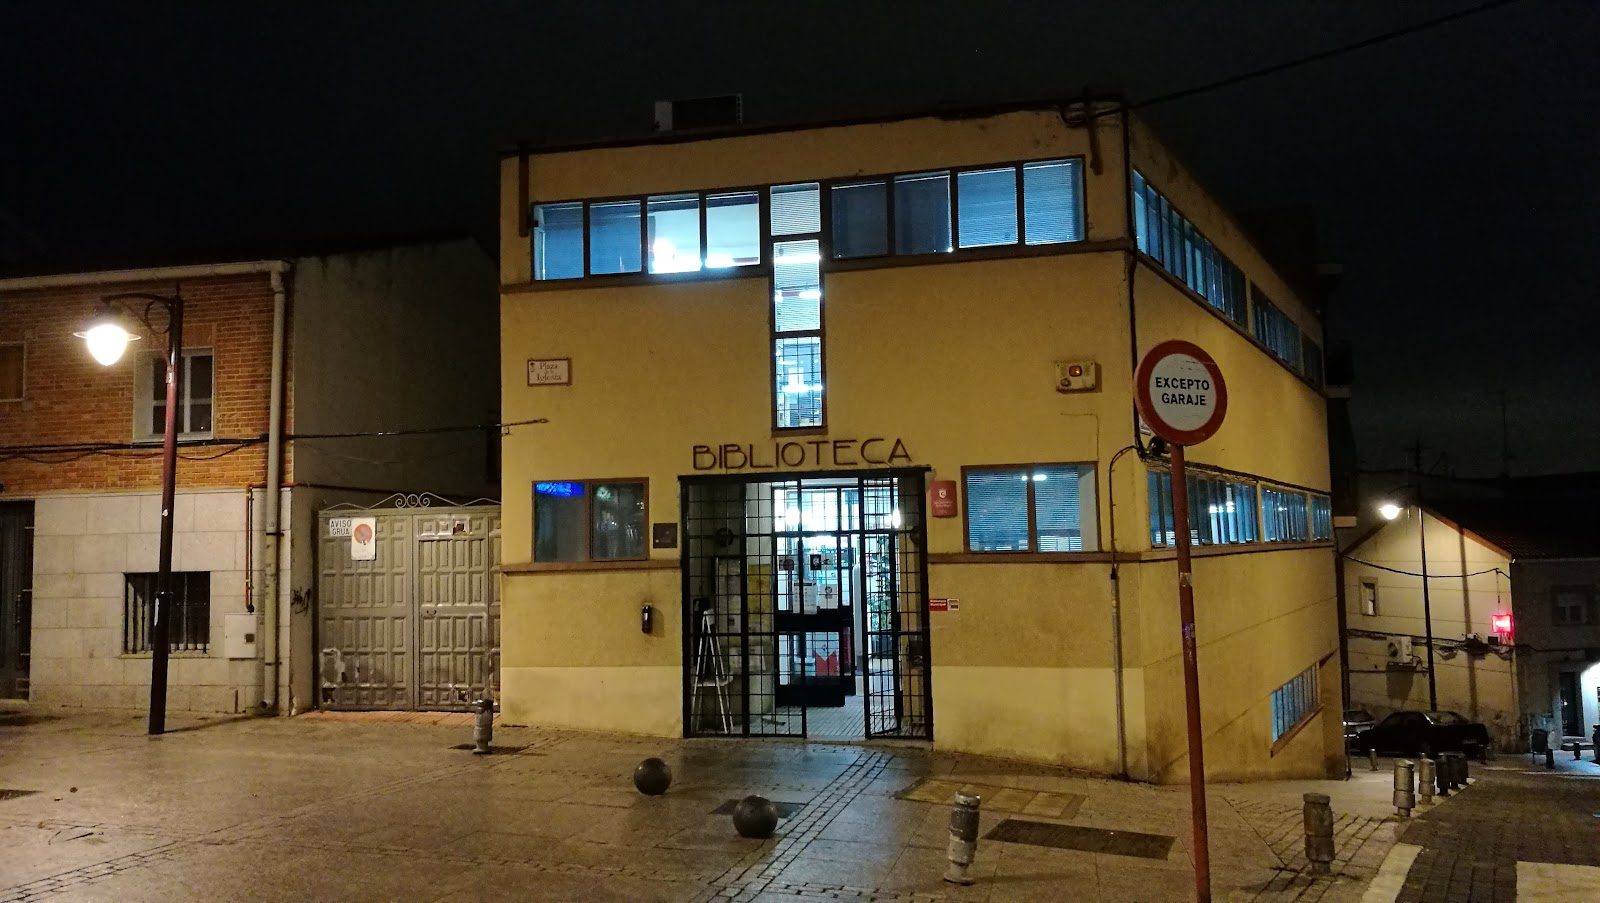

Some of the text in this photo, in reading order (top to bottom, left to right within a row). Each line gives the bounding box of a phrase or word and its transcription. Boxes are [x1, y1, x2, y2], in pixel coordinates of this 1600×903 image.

[539, 361, 558, 369] Plaza
[1155, 377, 1210, 391] EXCEPTO
[1162, 393, 1207, 406] GARAJE
[692, 438, 913, 470] BIBLIOTECA
[330, 519, 352, 528] AVISO
[332, 528, 350, 536] GRUA
